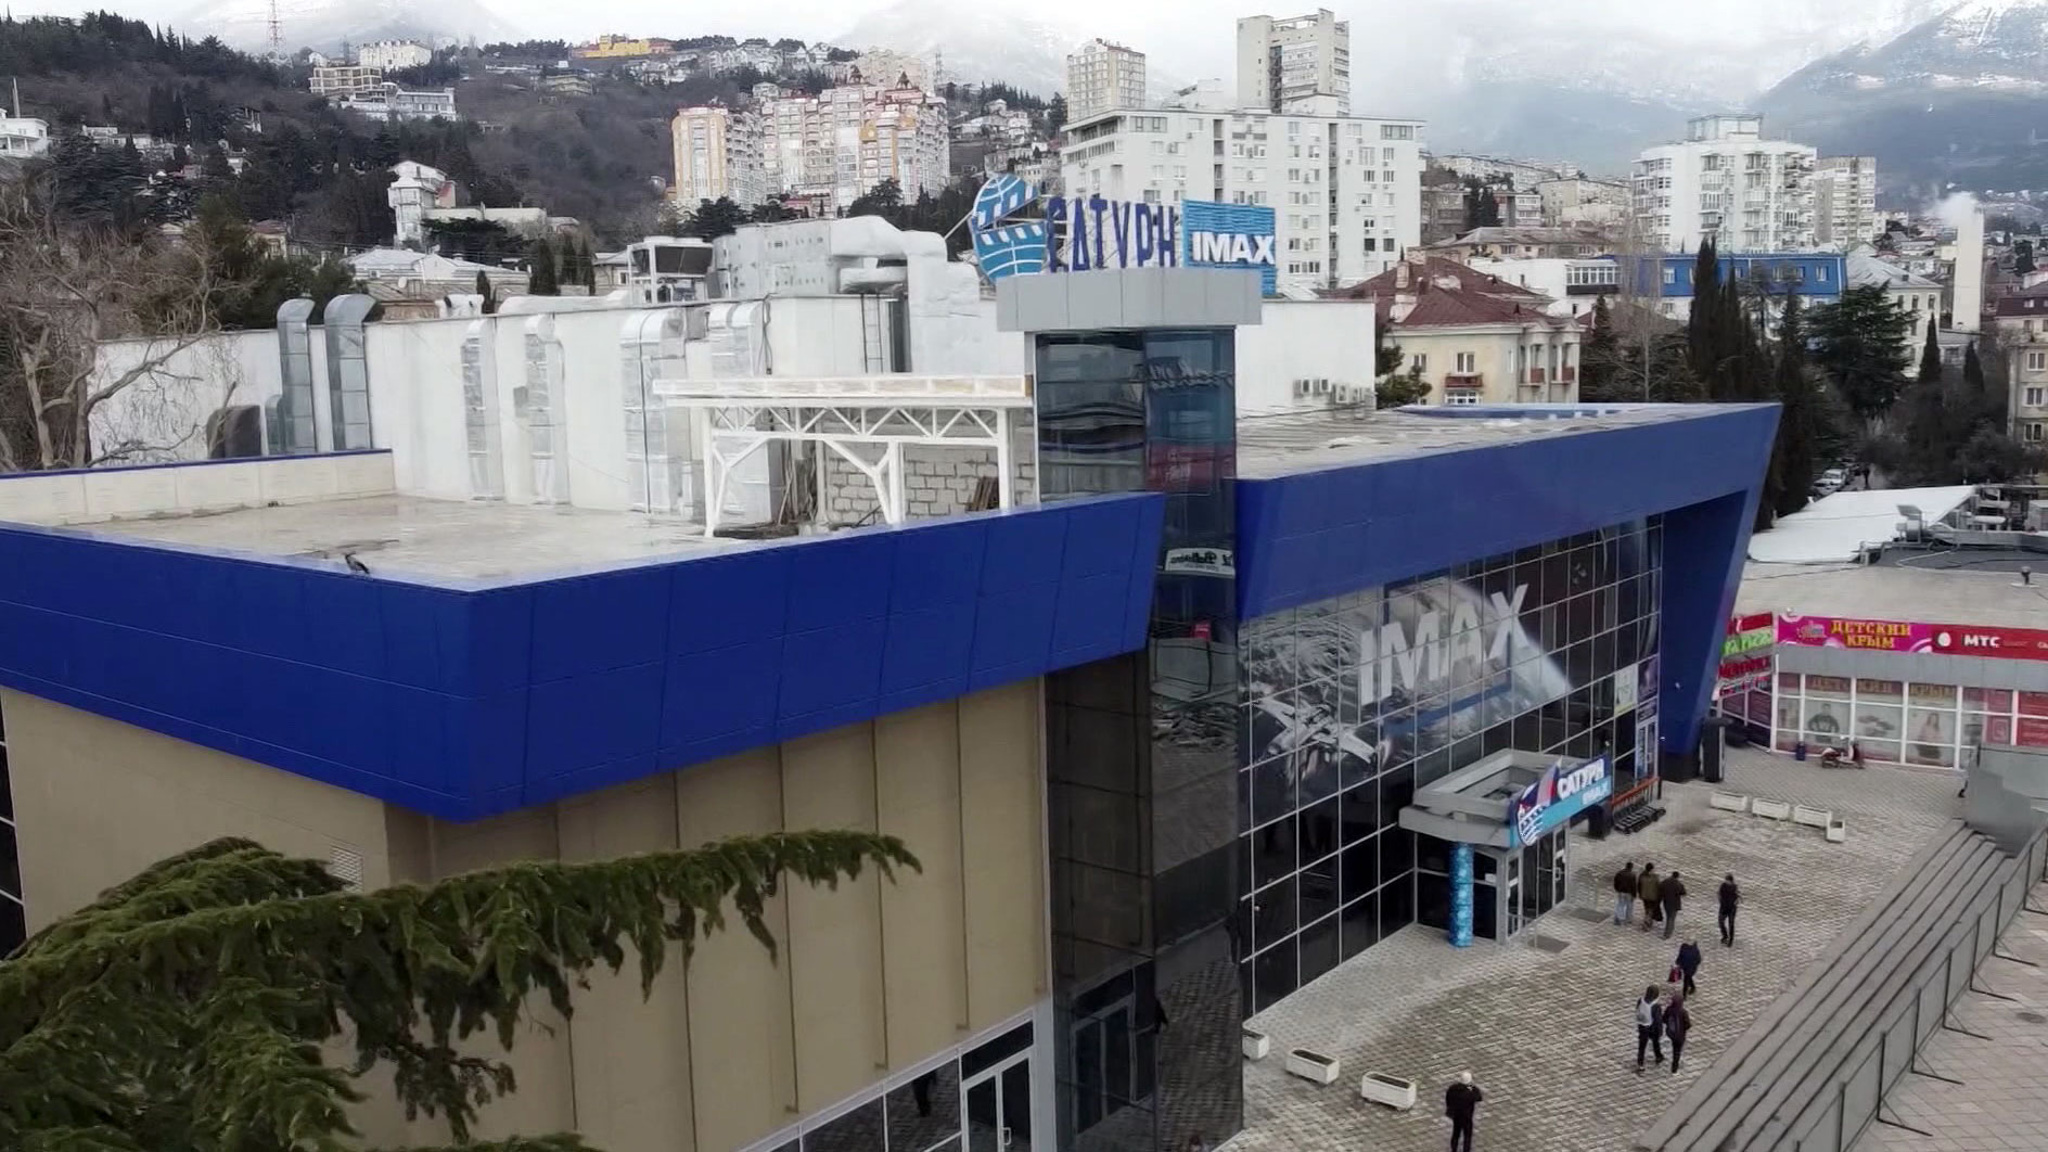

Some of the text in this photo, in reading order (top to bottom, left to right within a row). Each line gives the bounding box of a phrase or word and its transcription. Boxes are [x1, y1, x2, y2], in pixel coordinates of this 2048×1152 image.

[1192, 231, 1275, 265] IMAX
[1358, 583, 1528, 706] IMAX
[1846, 634, 1895, 649] КРЫМ
[1963, 634, 2001, 648] МТС
[1557, 758, 1605, 800] САТУРН
